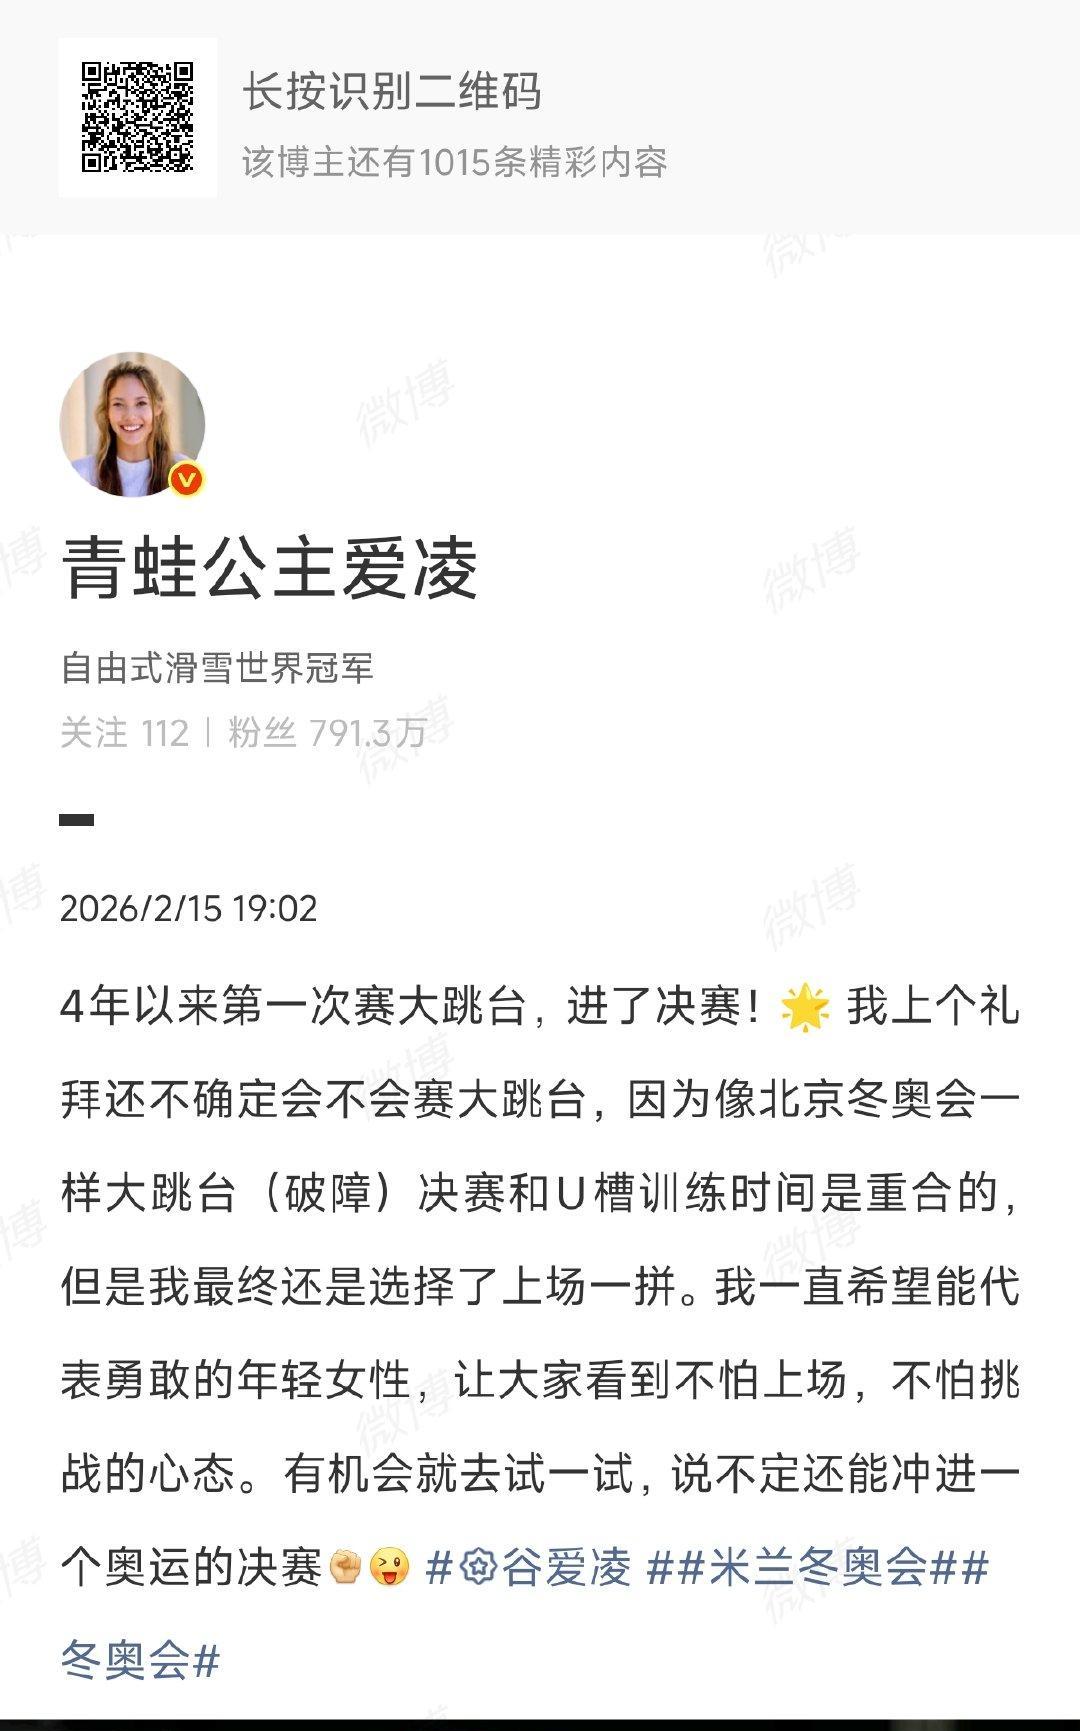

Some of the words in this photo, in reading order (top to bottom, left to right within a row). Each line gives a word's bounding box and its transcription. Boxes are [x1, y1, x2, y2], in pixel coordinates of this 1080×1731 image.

[242, 69, 541, 111] 长按识别二维码
[242, 144, 667, 179] 该博主还有1015条精彩内容
[62, 533, 477, 600] 青蛙公主爱凌
[63, 650, 374, 685] 自由式滑雪世界冠军
[61, 715, 128, 748] 关注
[142, 719, 189, 747] 112
[228, 715, 297, 749] 粉丝
[309, 717, 428, 748] 791.3万
[60, 894, 222, 922] 2026/2/15
[233, 894, 317, 922] 19:02
[61, 1545, 323, 1588] 个奥运的决赛
[61, 1638, 221, 1681] 冬奥会#
